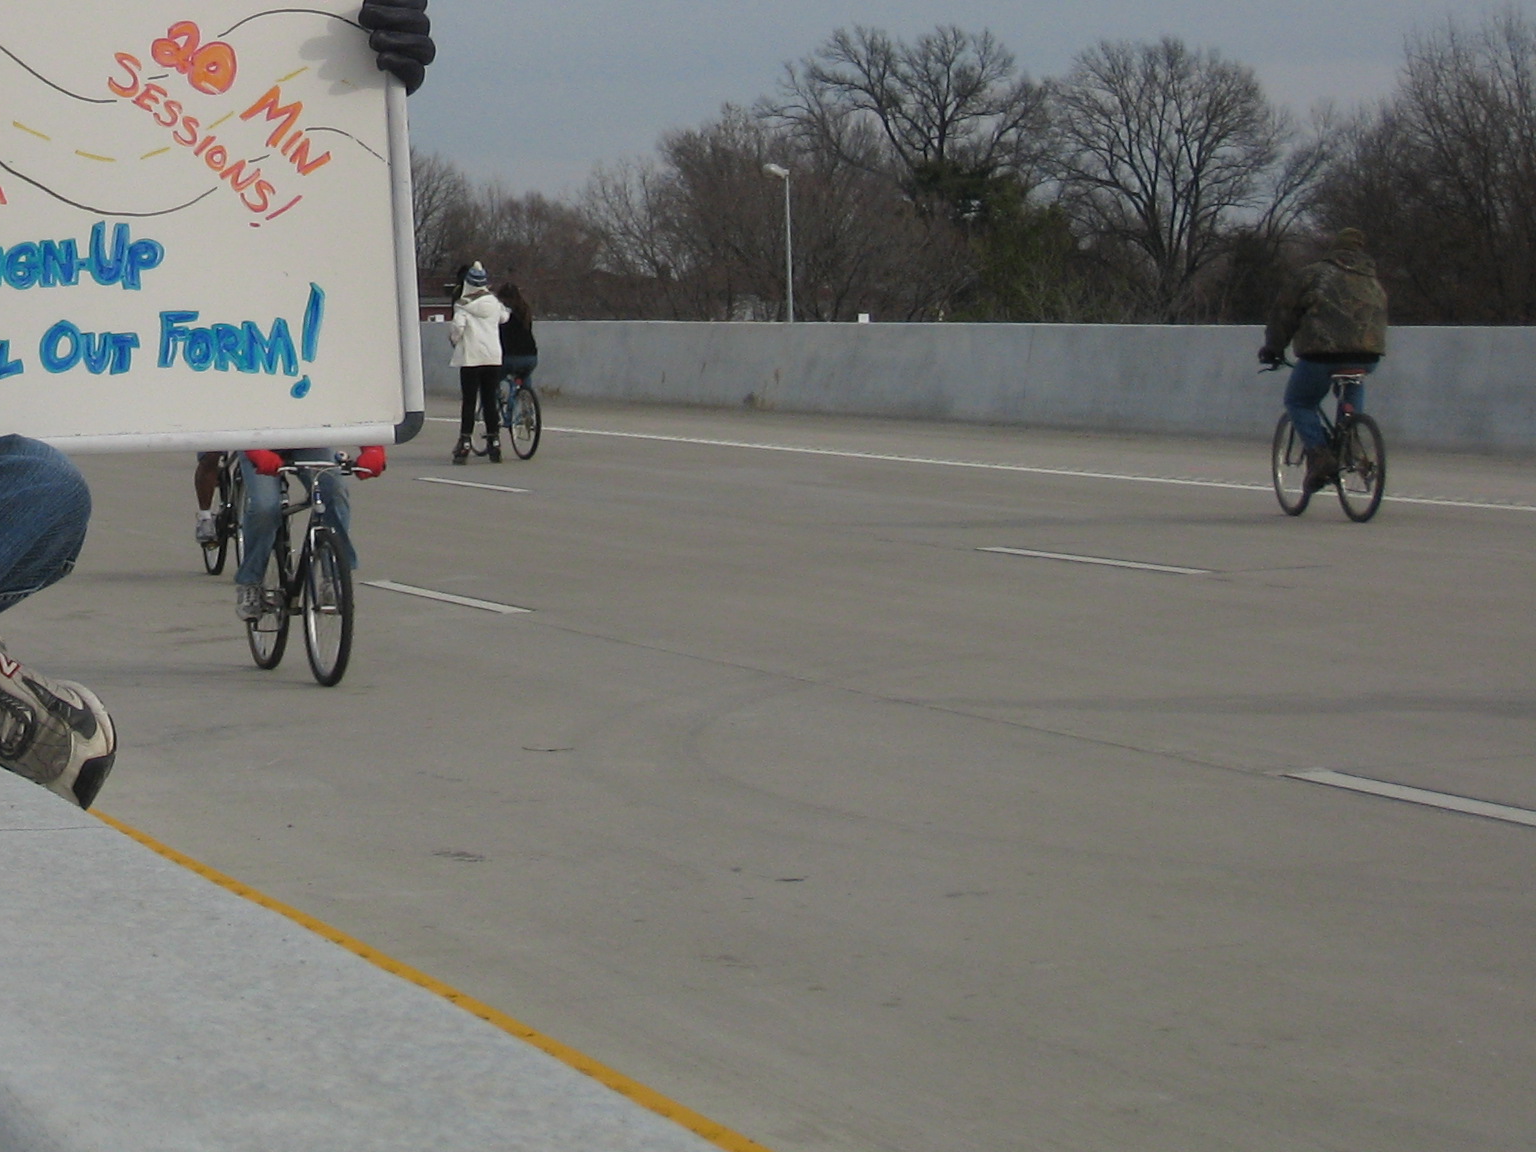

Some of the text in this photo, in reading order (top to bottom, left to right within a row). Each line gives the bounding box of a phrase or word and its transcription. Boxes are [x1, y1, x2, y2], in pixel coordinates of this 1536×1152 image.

[108, 52, 303, 228] SESSIONS!
[239, 85, 331, 176] MIN
[40, 319, 140, 376] OUT
[158, 281, 325, 399] FORM!
